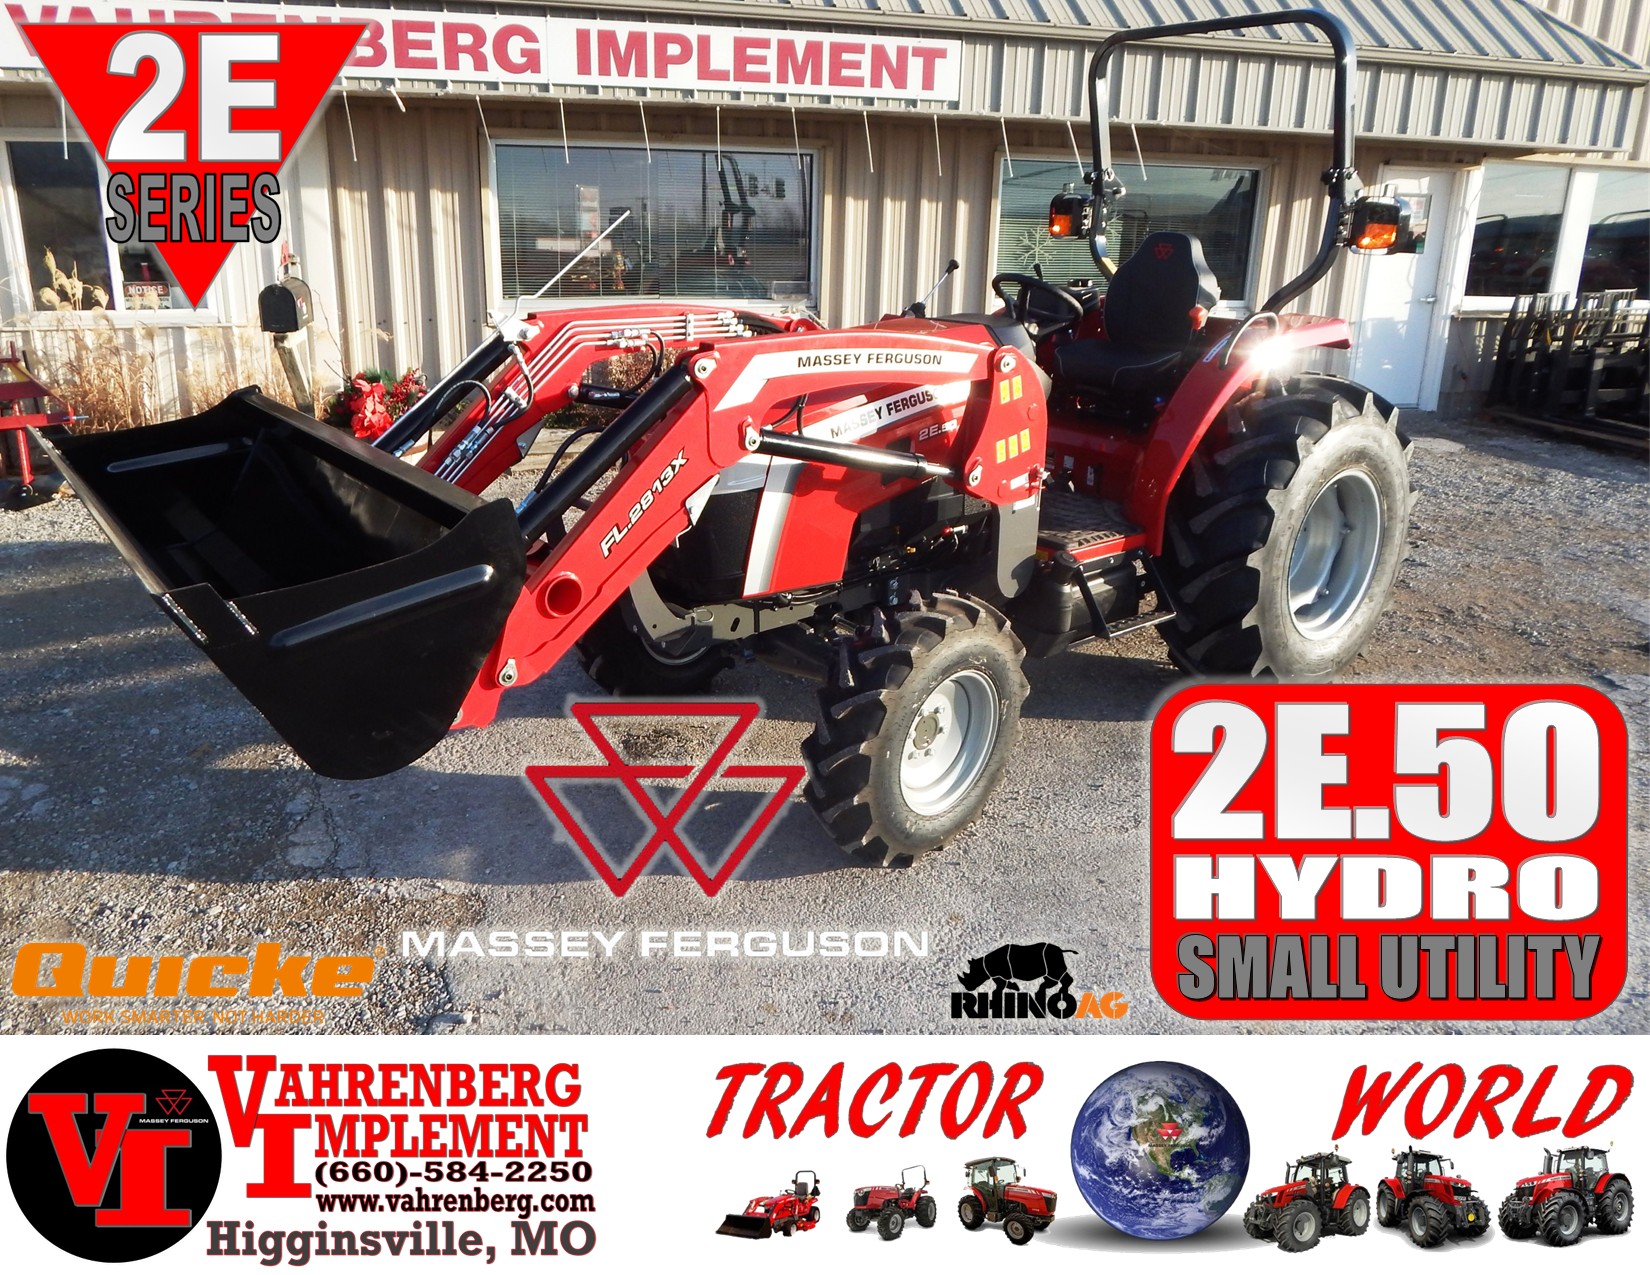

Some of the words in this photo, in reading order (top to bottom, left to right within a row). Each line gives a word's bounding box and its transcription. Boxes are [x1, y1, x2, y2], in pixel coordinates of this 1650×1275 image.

[576, 28, 947, 91] IMPLEMENT
[797, 354, 861, 368] MASSEY
[867, 353, 942, 365] FERGUSON
[600, 446, 689, 559] FL.2813X
